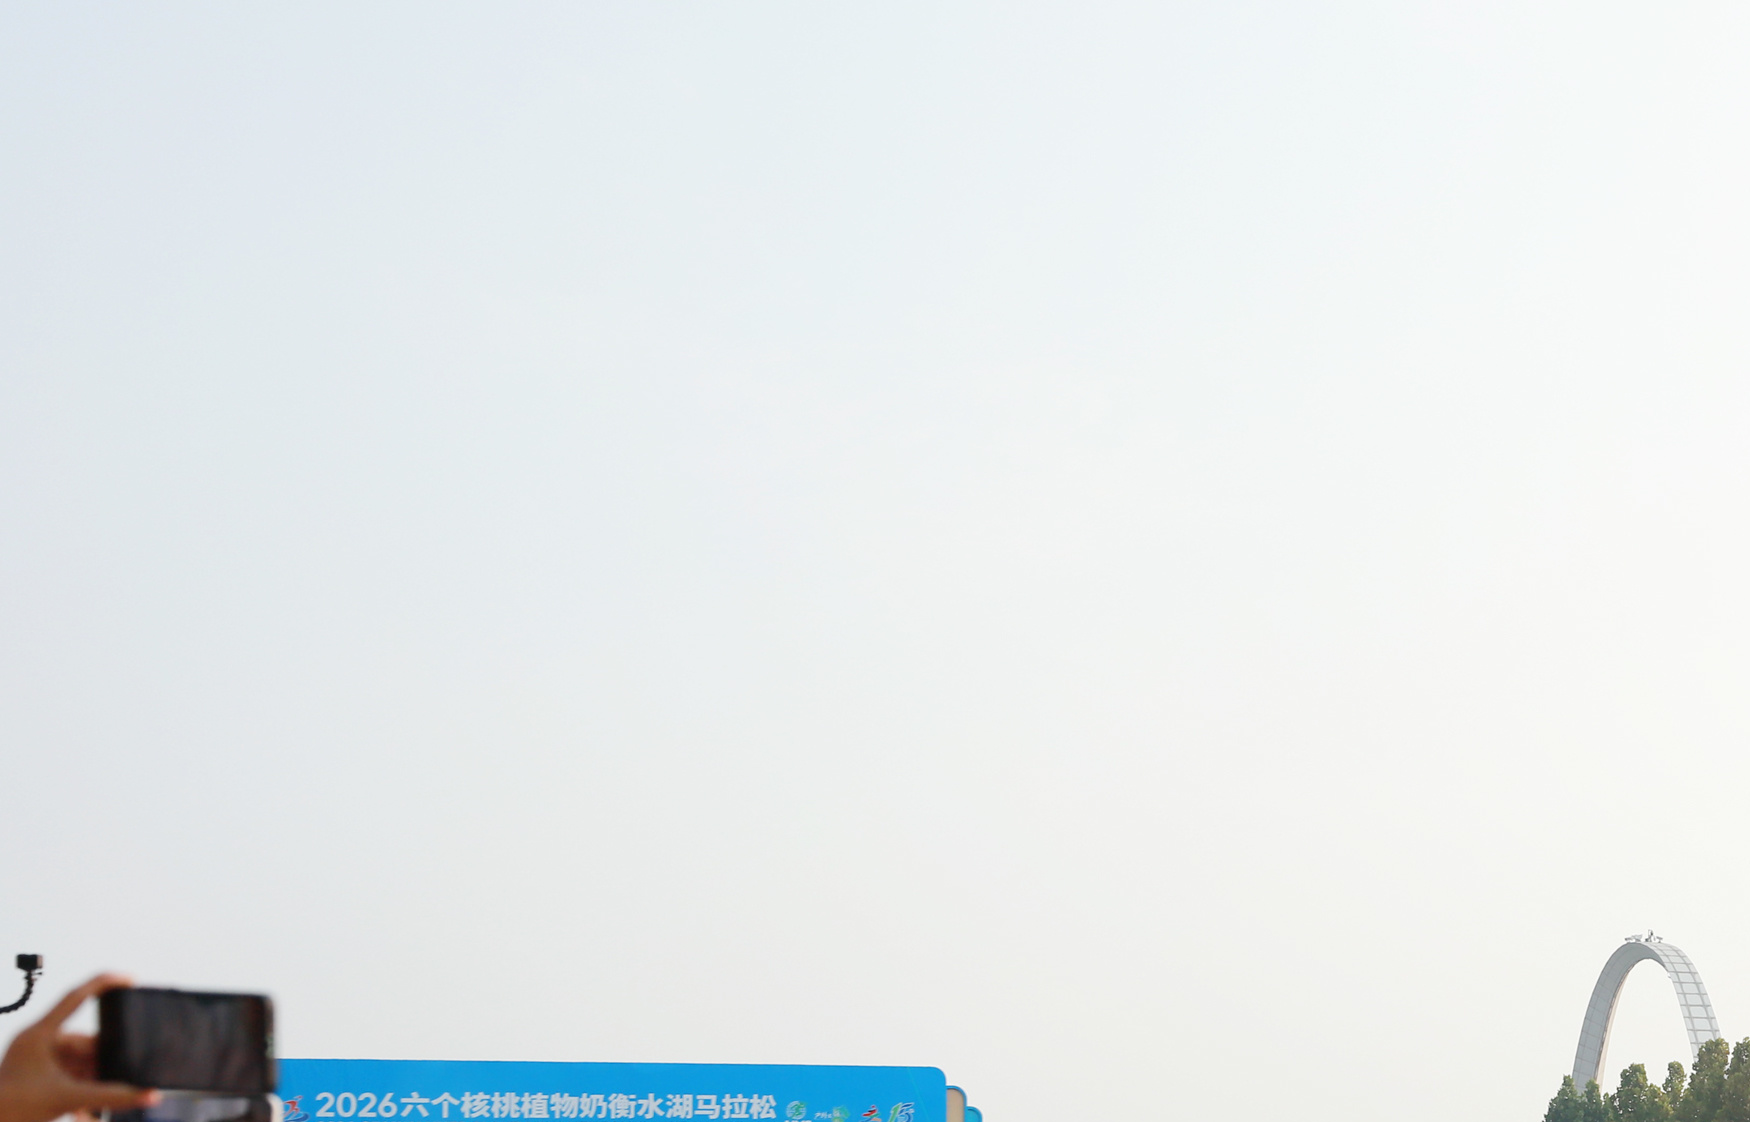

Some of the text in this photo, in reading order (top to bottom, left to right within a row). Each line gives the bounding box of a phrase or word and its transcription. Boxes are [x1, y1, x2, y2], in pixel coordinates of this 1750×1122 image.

[315, 1091, 777, 1119] 2026六个核桃植物奶衡水湖马拉松
